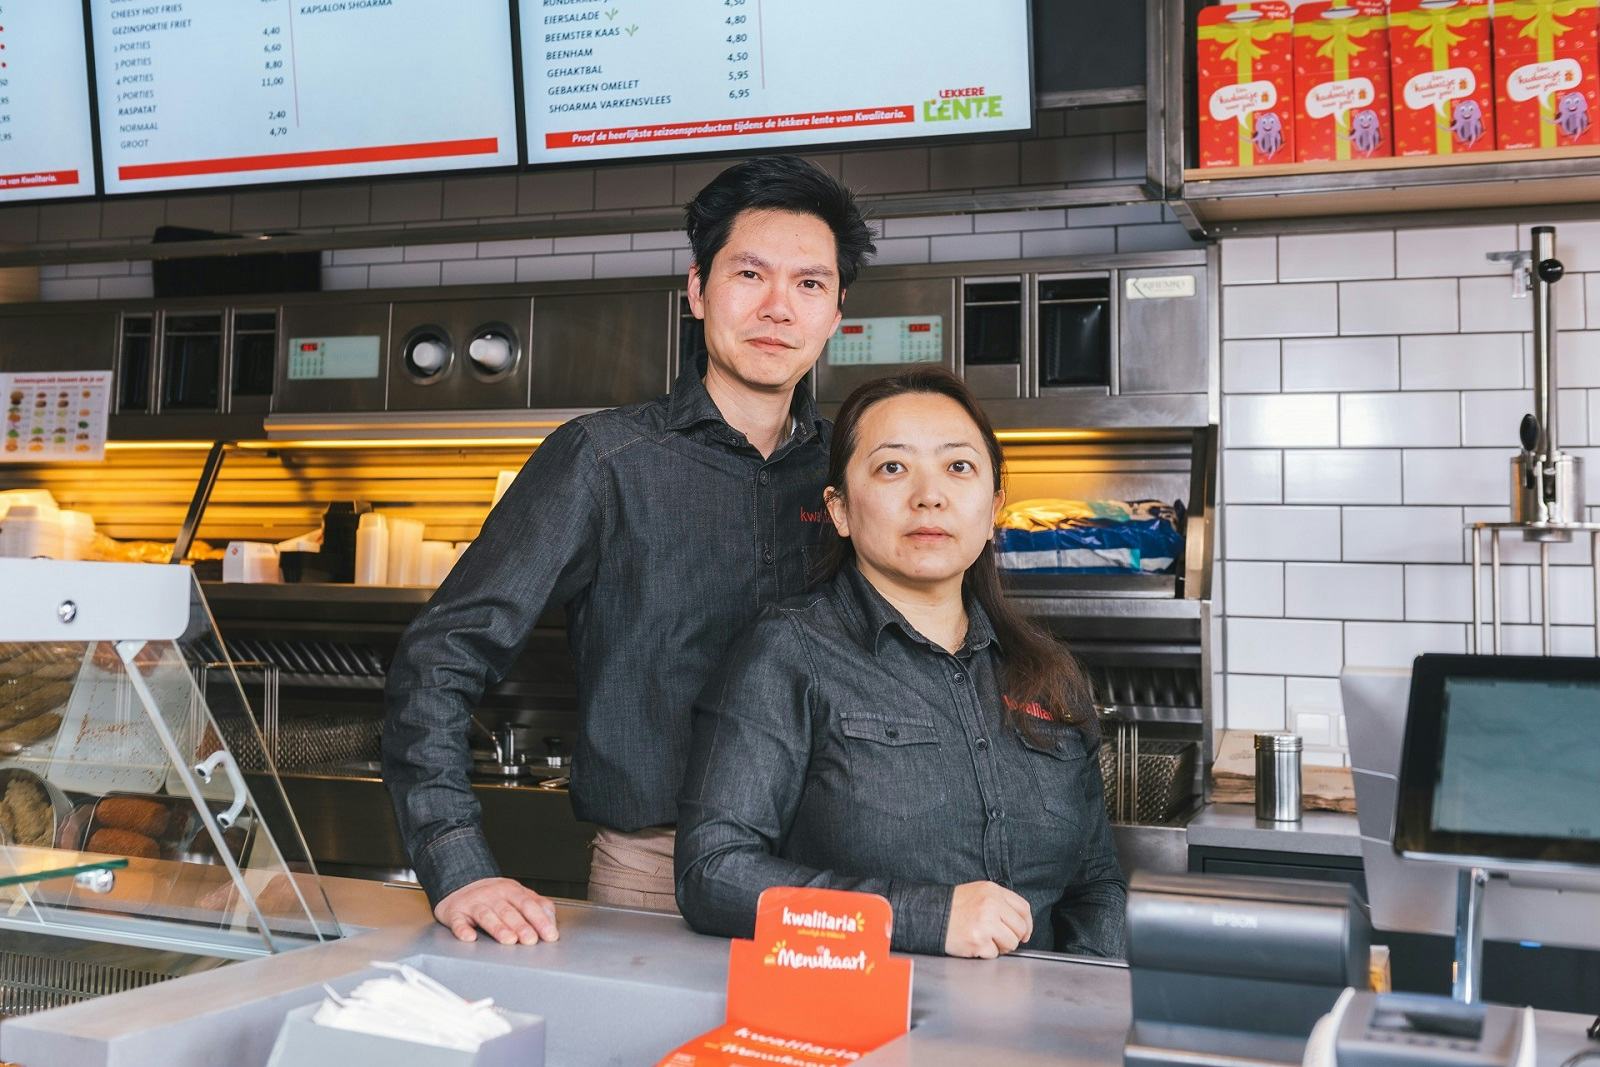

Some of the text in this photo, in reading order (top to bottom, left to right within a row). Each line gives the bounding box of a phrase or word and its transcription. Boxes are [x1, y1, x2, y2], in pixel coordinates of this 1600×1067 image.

[111, 3, 183, 19] CHEESY HOT FRIES
[300, 3, 346, 15] KAPSALON
[544, 11, 600, 25] EIERSALADE
[725, 15, 746, 26] 4,80
[112, 18, 192, 36] GEZINSPORTIE FRIET
[262, 26, 280, 36] 4,40
[545, 27, 621, 43] BEEMSTER KAAS
[726, 34, 747, 44] 4,80
[119, 40, 151, 52] PORTIES
[263, 43, 282, 53] 6,60
[546, 48, 593, 60] BEENHAM
[727, 52, 749, 63] 4,50
[120, 57, 152, 68] PORTIES
[265, 60, 283, 70] 8,80
[547, 65, 603, 78] GEHAKTBAL
[728, 70, 749, 81] 5,95
[122, 73, 154, 85] PORTIES
[261, 76, 284, 87] 11,00
[548, 79, 639, 96] GEBAKKEN OMELET
[729, 88, 750, 99] 6,95
[939, 86, 985, 99] LEKKERE
[122, 89, 155, 101] PORTIES
[118, 104, 157, 116] RASPATAT
[549, 95, 672, 114] SHOARMA VARKENSVLEES
[923, 95, 1003, 122] LENTE
[268, 110, 287, 120] 2,40
[119, 121, 159, 133] NORMAAL
[269, 126, 288, 137] 4,70
[572, 109, 907, 144] Proef de heerlijkste seizoensproducten tijdens de lekkere lente van Kwalitaria.
[120, 138, 149, 149] GROOT
[782, 906, 857, 933] kwalitaria
[777, 947, 867, 971] Menukaart
